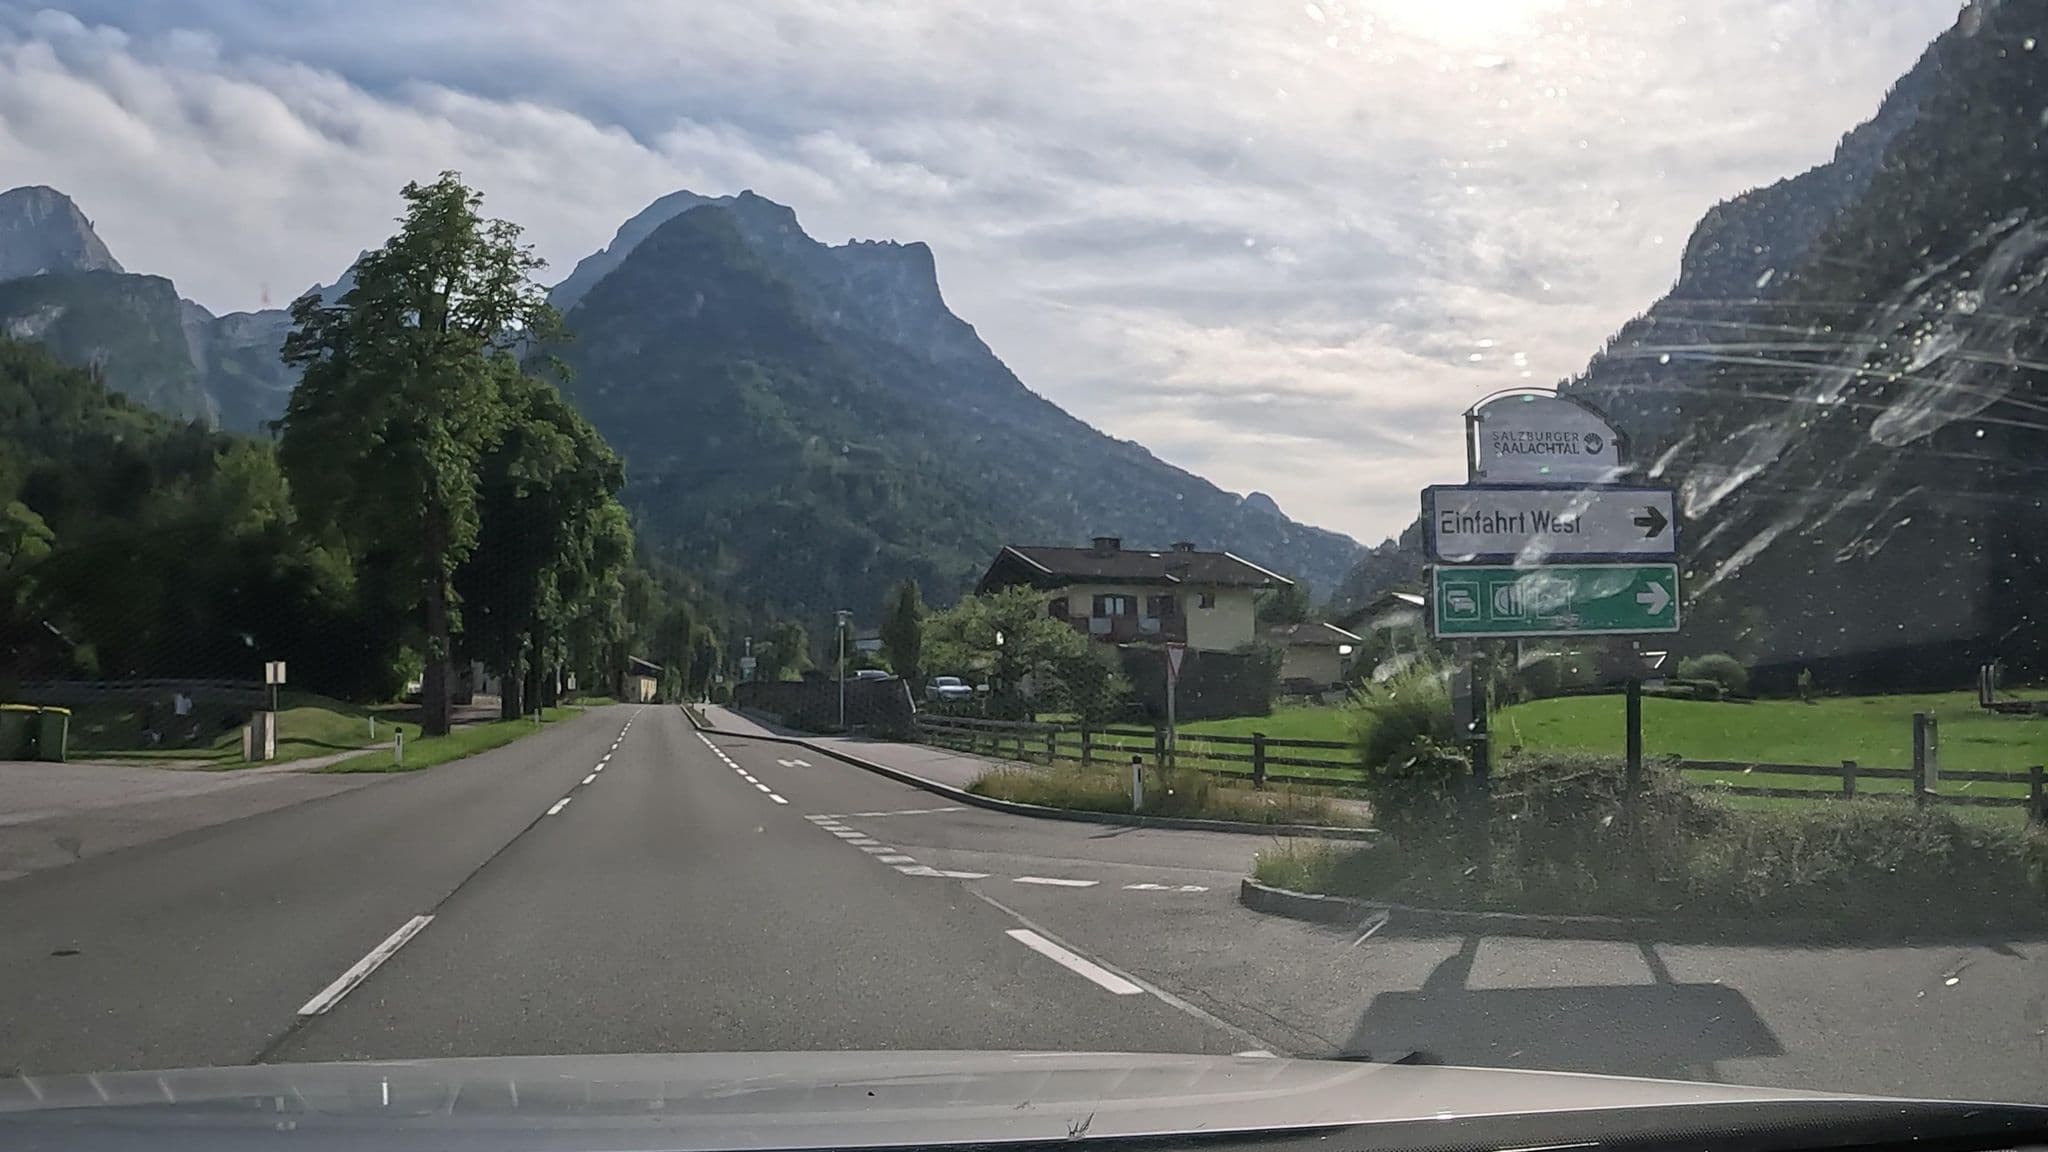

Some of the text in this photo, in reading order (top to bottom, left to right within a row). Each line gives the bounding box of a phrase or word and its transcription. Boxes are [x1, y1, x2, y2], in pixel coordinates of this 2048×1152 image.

[1493, 431, 1580, 442] SALZBURGER
[1494, 442, 1580, 455] SAALACHTAL
[1441, 510, 1581, 534] Einfahrt West
